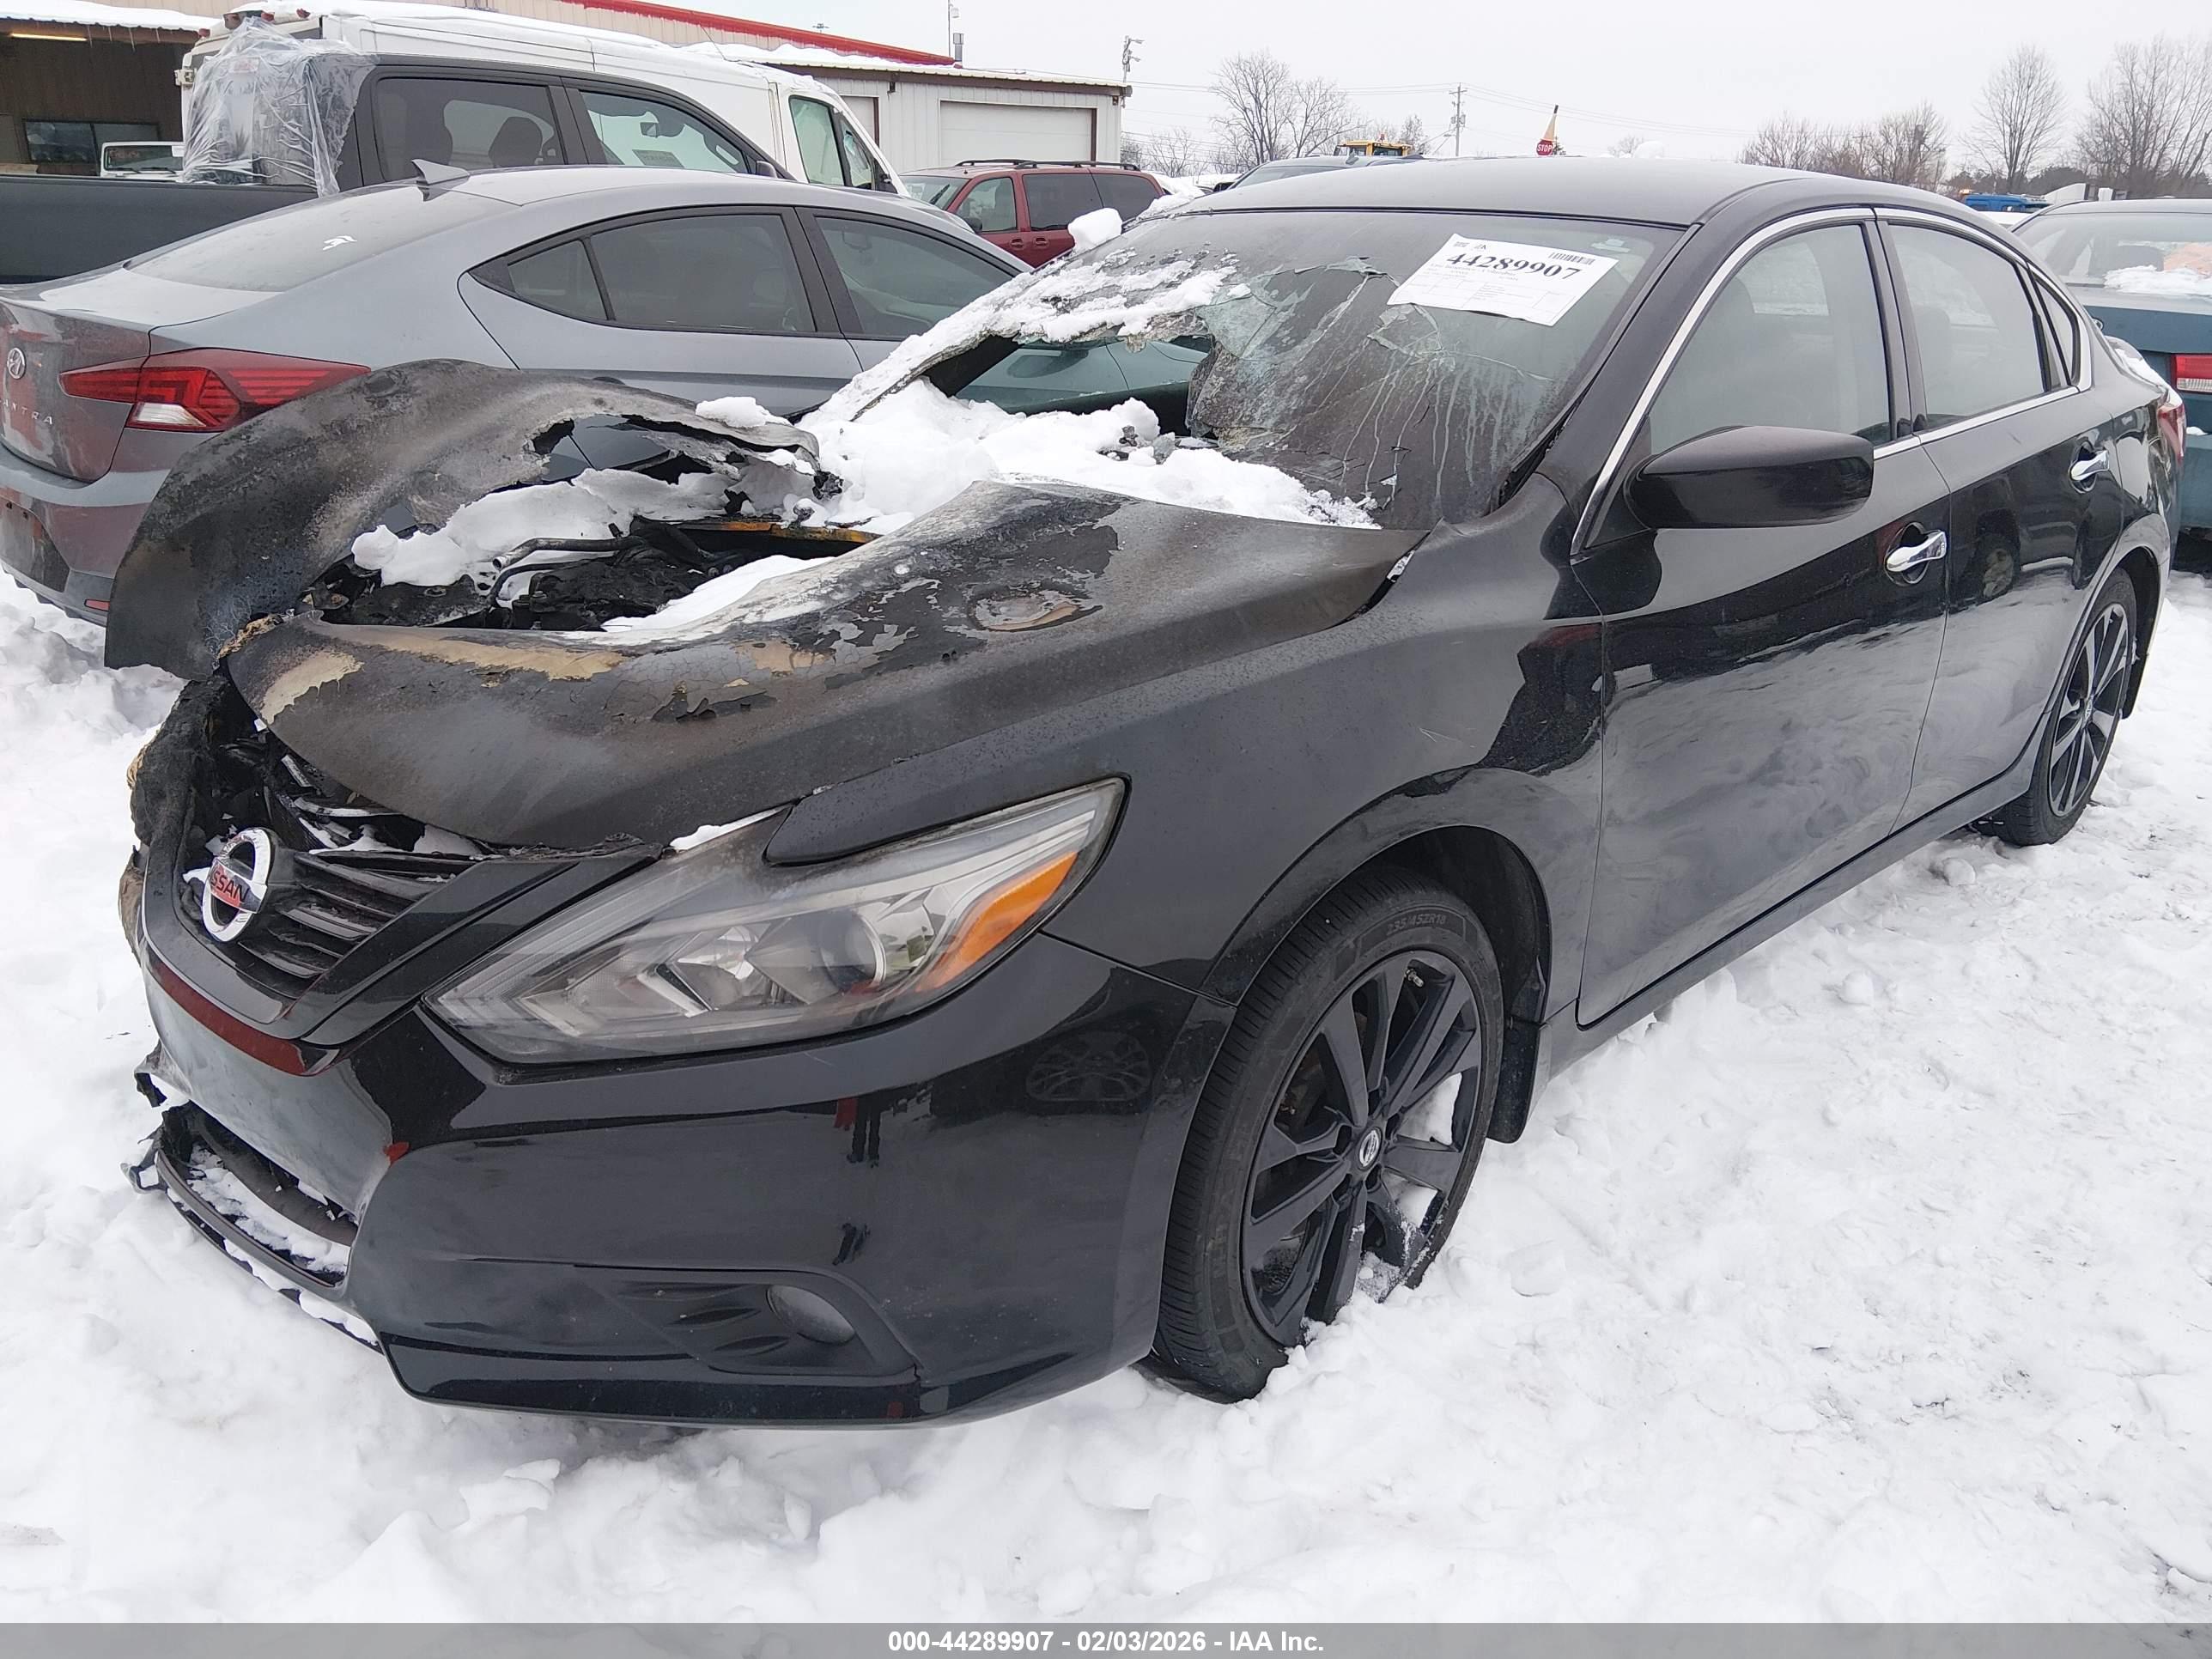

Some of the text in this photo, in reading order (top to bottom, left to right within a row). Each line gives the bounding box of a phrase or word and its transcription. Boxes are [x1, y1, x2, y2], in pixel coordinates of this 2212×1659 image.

[1537, 143, 1553, 153] STOP
[1447, 252, 1583, 280] 44289907
[0, 398, 53, 425] ANTRA
[209, 869, 251, 903] SSAN
